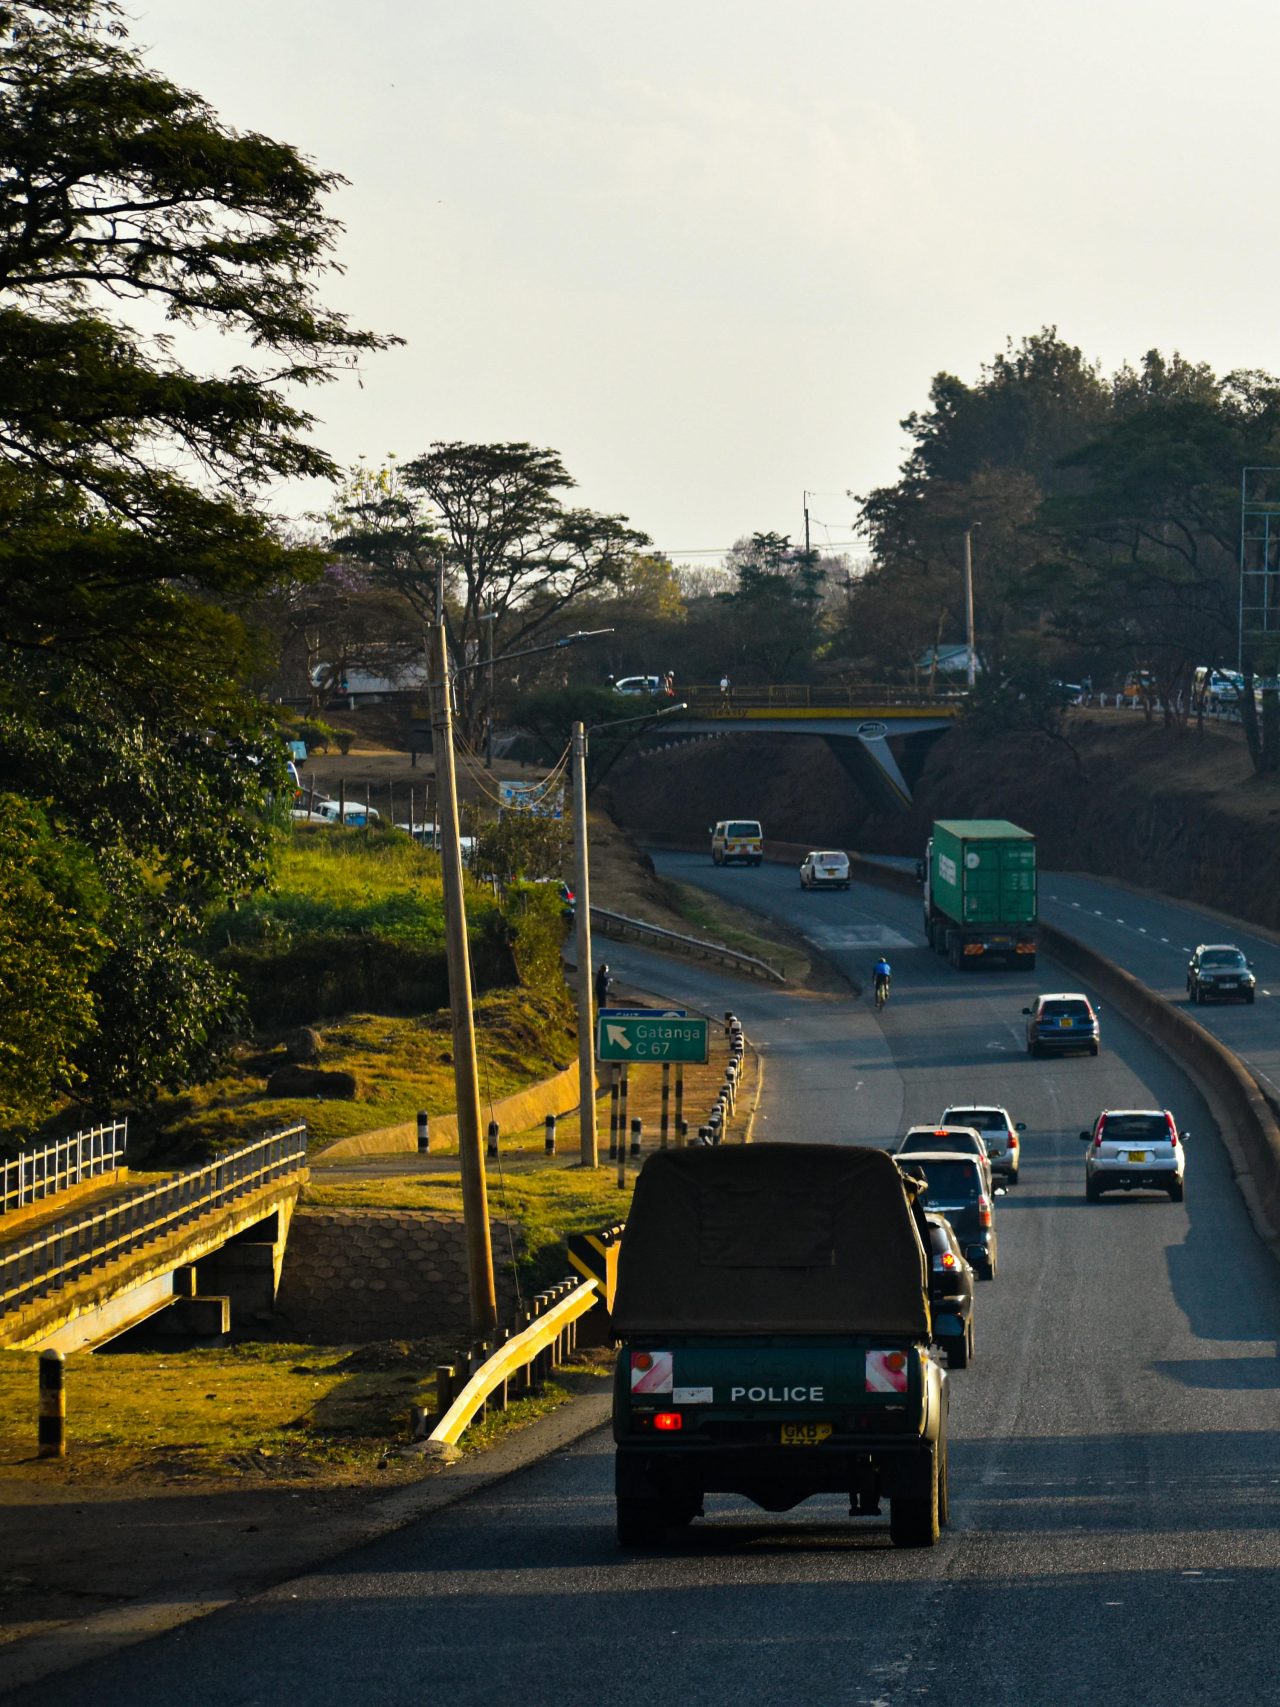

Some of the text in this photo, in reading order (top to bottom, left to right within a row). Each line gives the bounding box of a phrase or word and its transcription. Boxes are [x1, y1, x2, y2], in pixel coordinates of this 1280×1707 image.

[636, 1025, 700, 1041] Gatanga
[636, 1042, 670, 1055] C 67
[731, 1386, 824, 1402] POLICE
